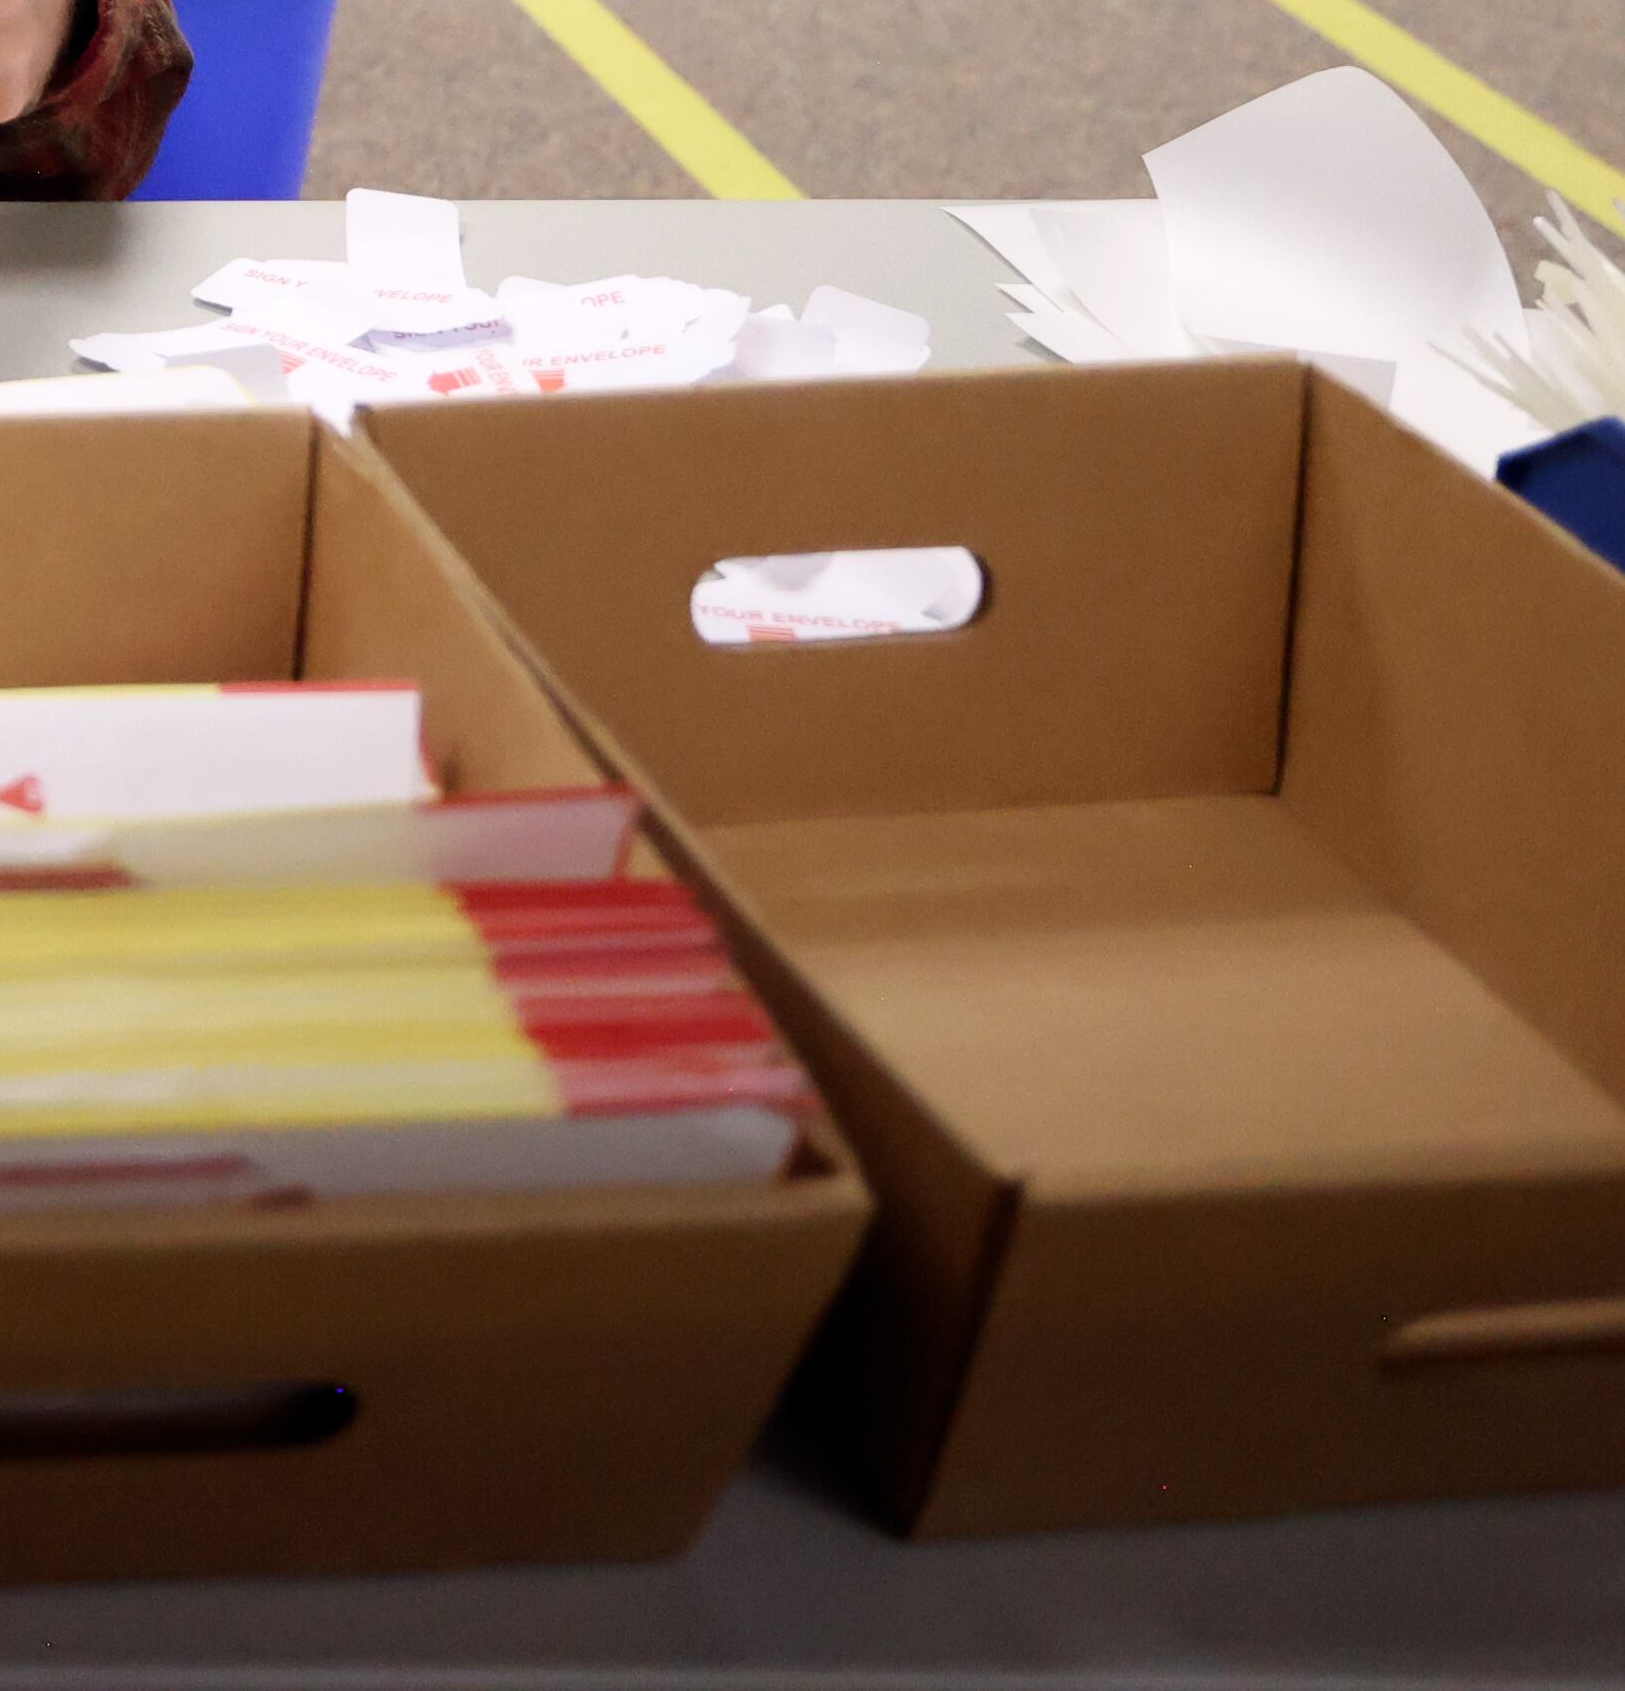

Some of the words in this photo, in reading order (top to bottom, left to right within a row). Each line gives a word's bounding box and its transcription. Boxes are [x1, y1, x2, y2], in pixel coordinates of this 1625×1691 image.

[244, 269, 291, 287] SIGN
[262, 330, 309, 350] YOUR
[305, 346, 398, 382] ENVELOPE
[550, 343, 667, 366] ENVELOPE
[771, 612, 902, 631] ENVELOPE
